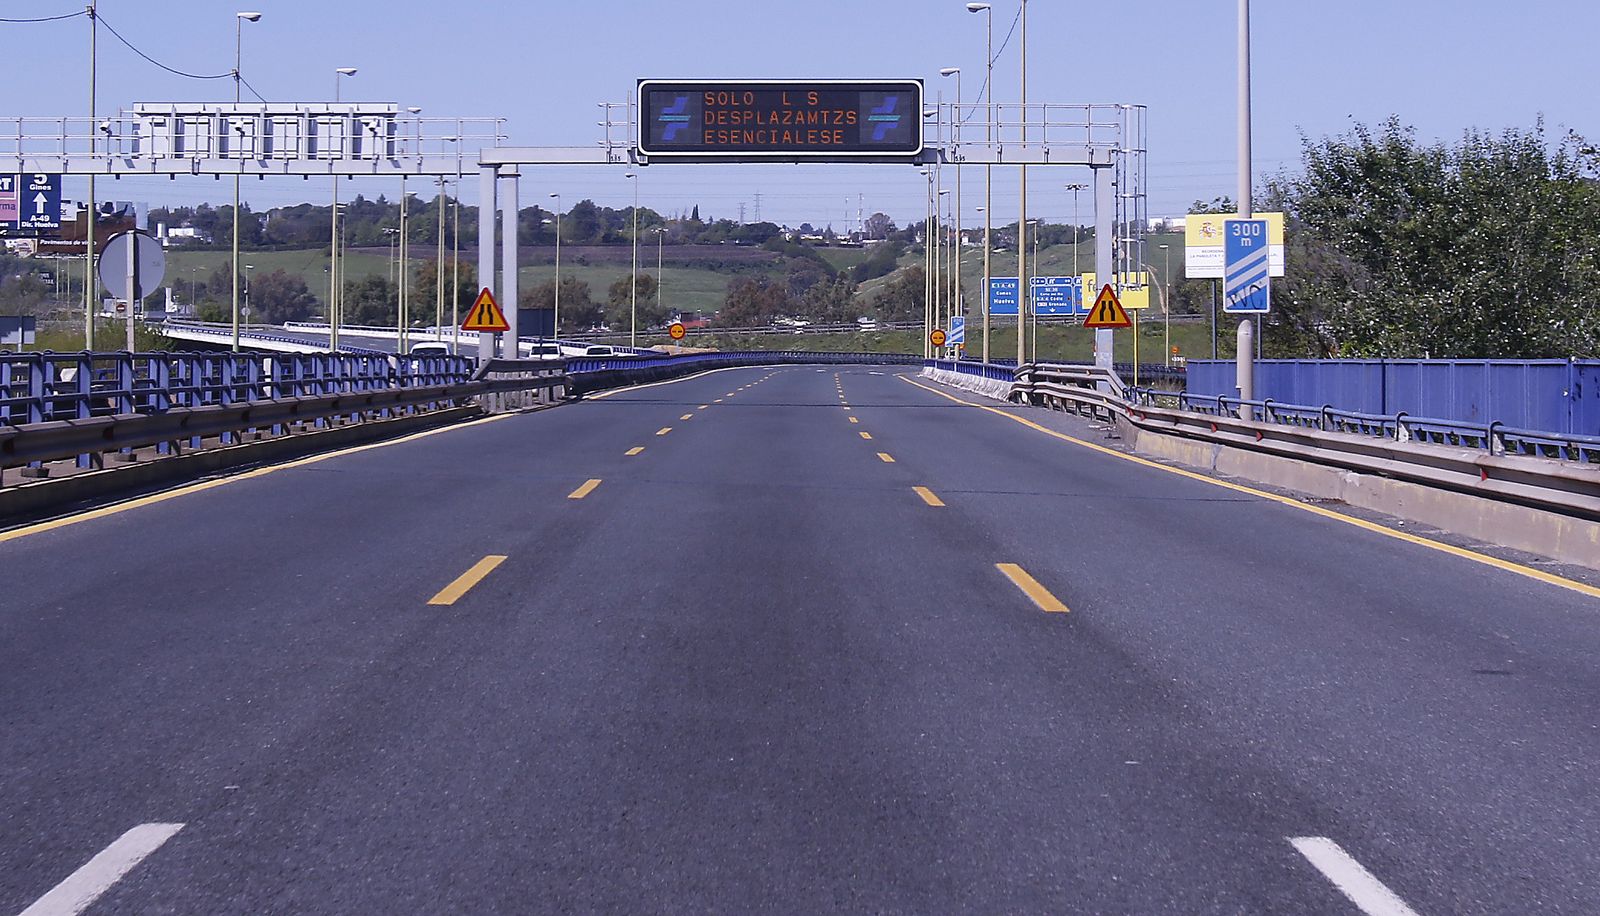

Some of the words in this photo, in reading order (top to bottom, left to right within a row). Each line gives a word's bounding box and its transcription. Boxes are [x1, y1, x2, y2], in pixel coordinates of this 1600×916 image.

[704, 91, 754, 106] SOLO
[782, 91, 792, 106] L
[807, 91, 819, 106] S
[704, 110, 857, 125] DESPLAZAMTZS
[704, 130, 844, 145] ESENCIALESE
[1232, 223, 1260, 236] 300
[1240, 237, 1252, 247] m
